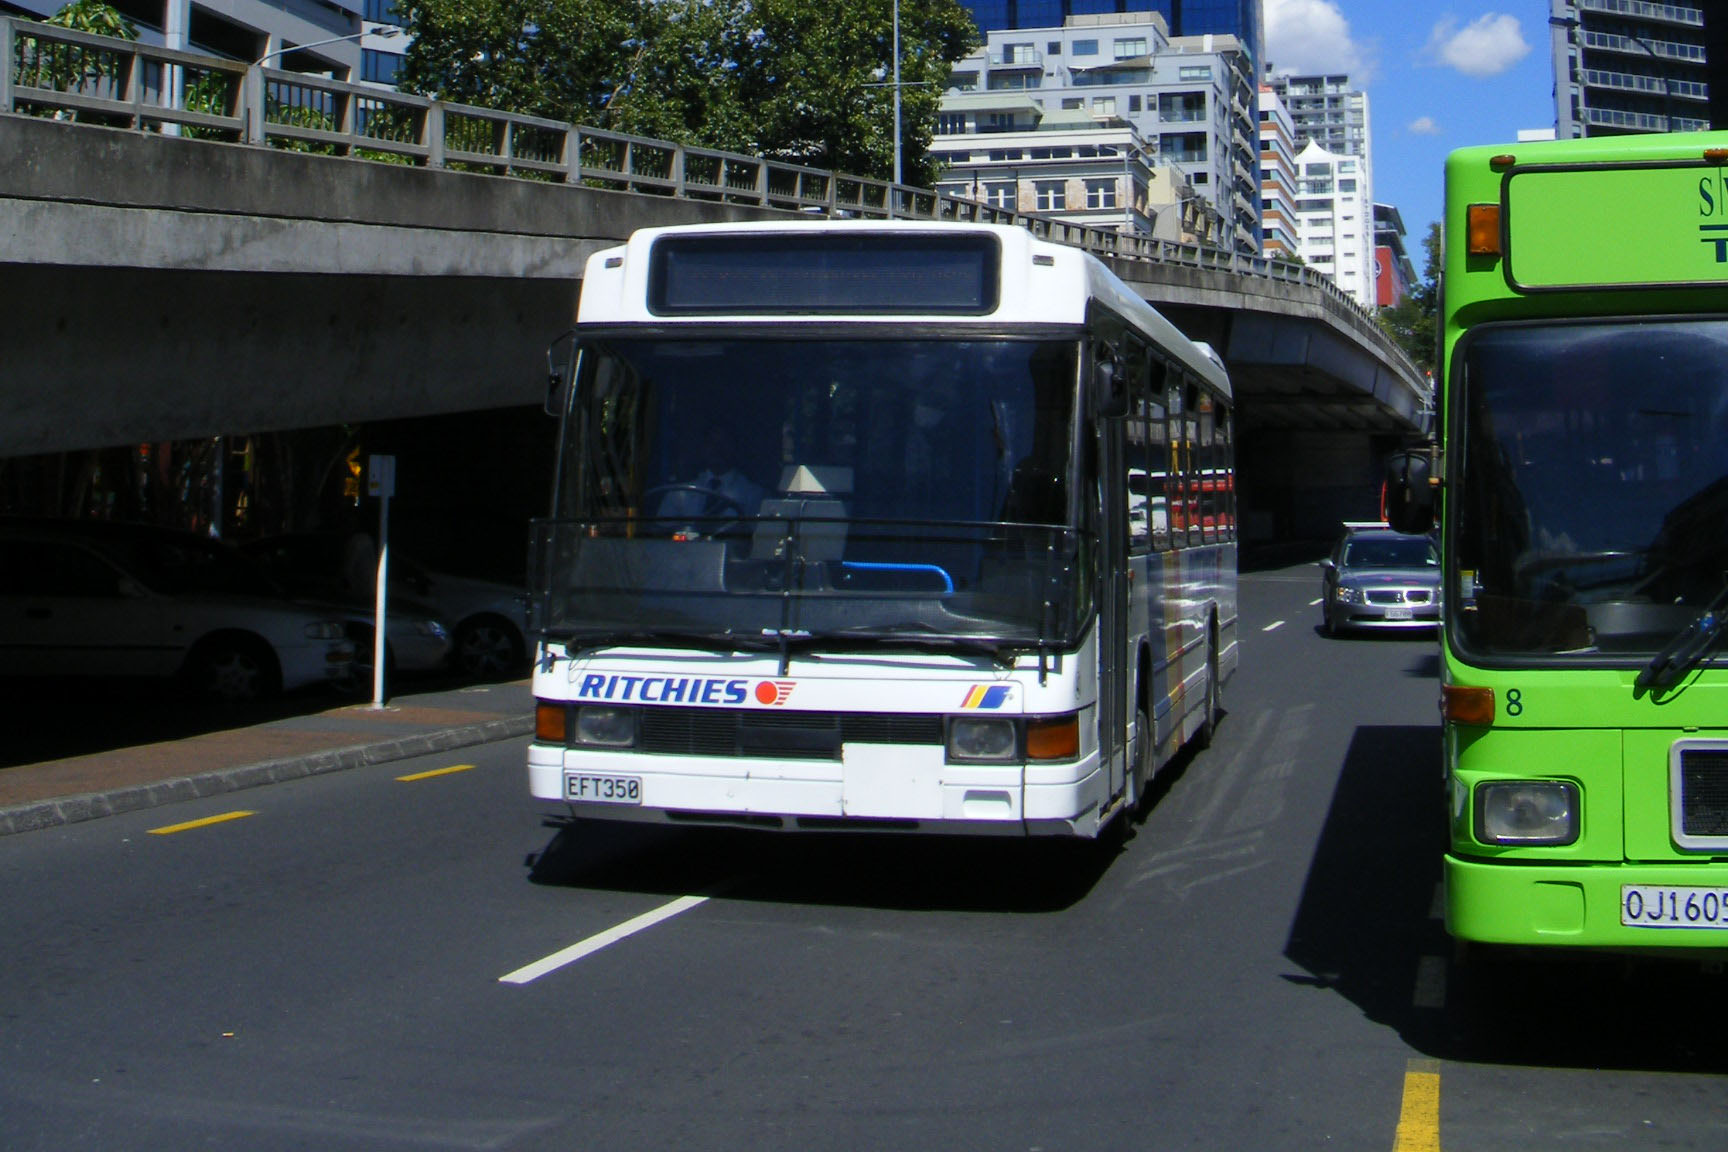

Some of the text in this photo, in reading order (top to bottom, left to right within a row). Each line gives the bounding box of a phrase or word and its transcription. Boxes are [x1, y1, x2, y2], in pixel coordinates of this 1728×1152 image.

[578, 674, 749, 704] RITCHIES
[1506, 688, 1523, 716] 8
[568, 776, 639, 799] EFT350
